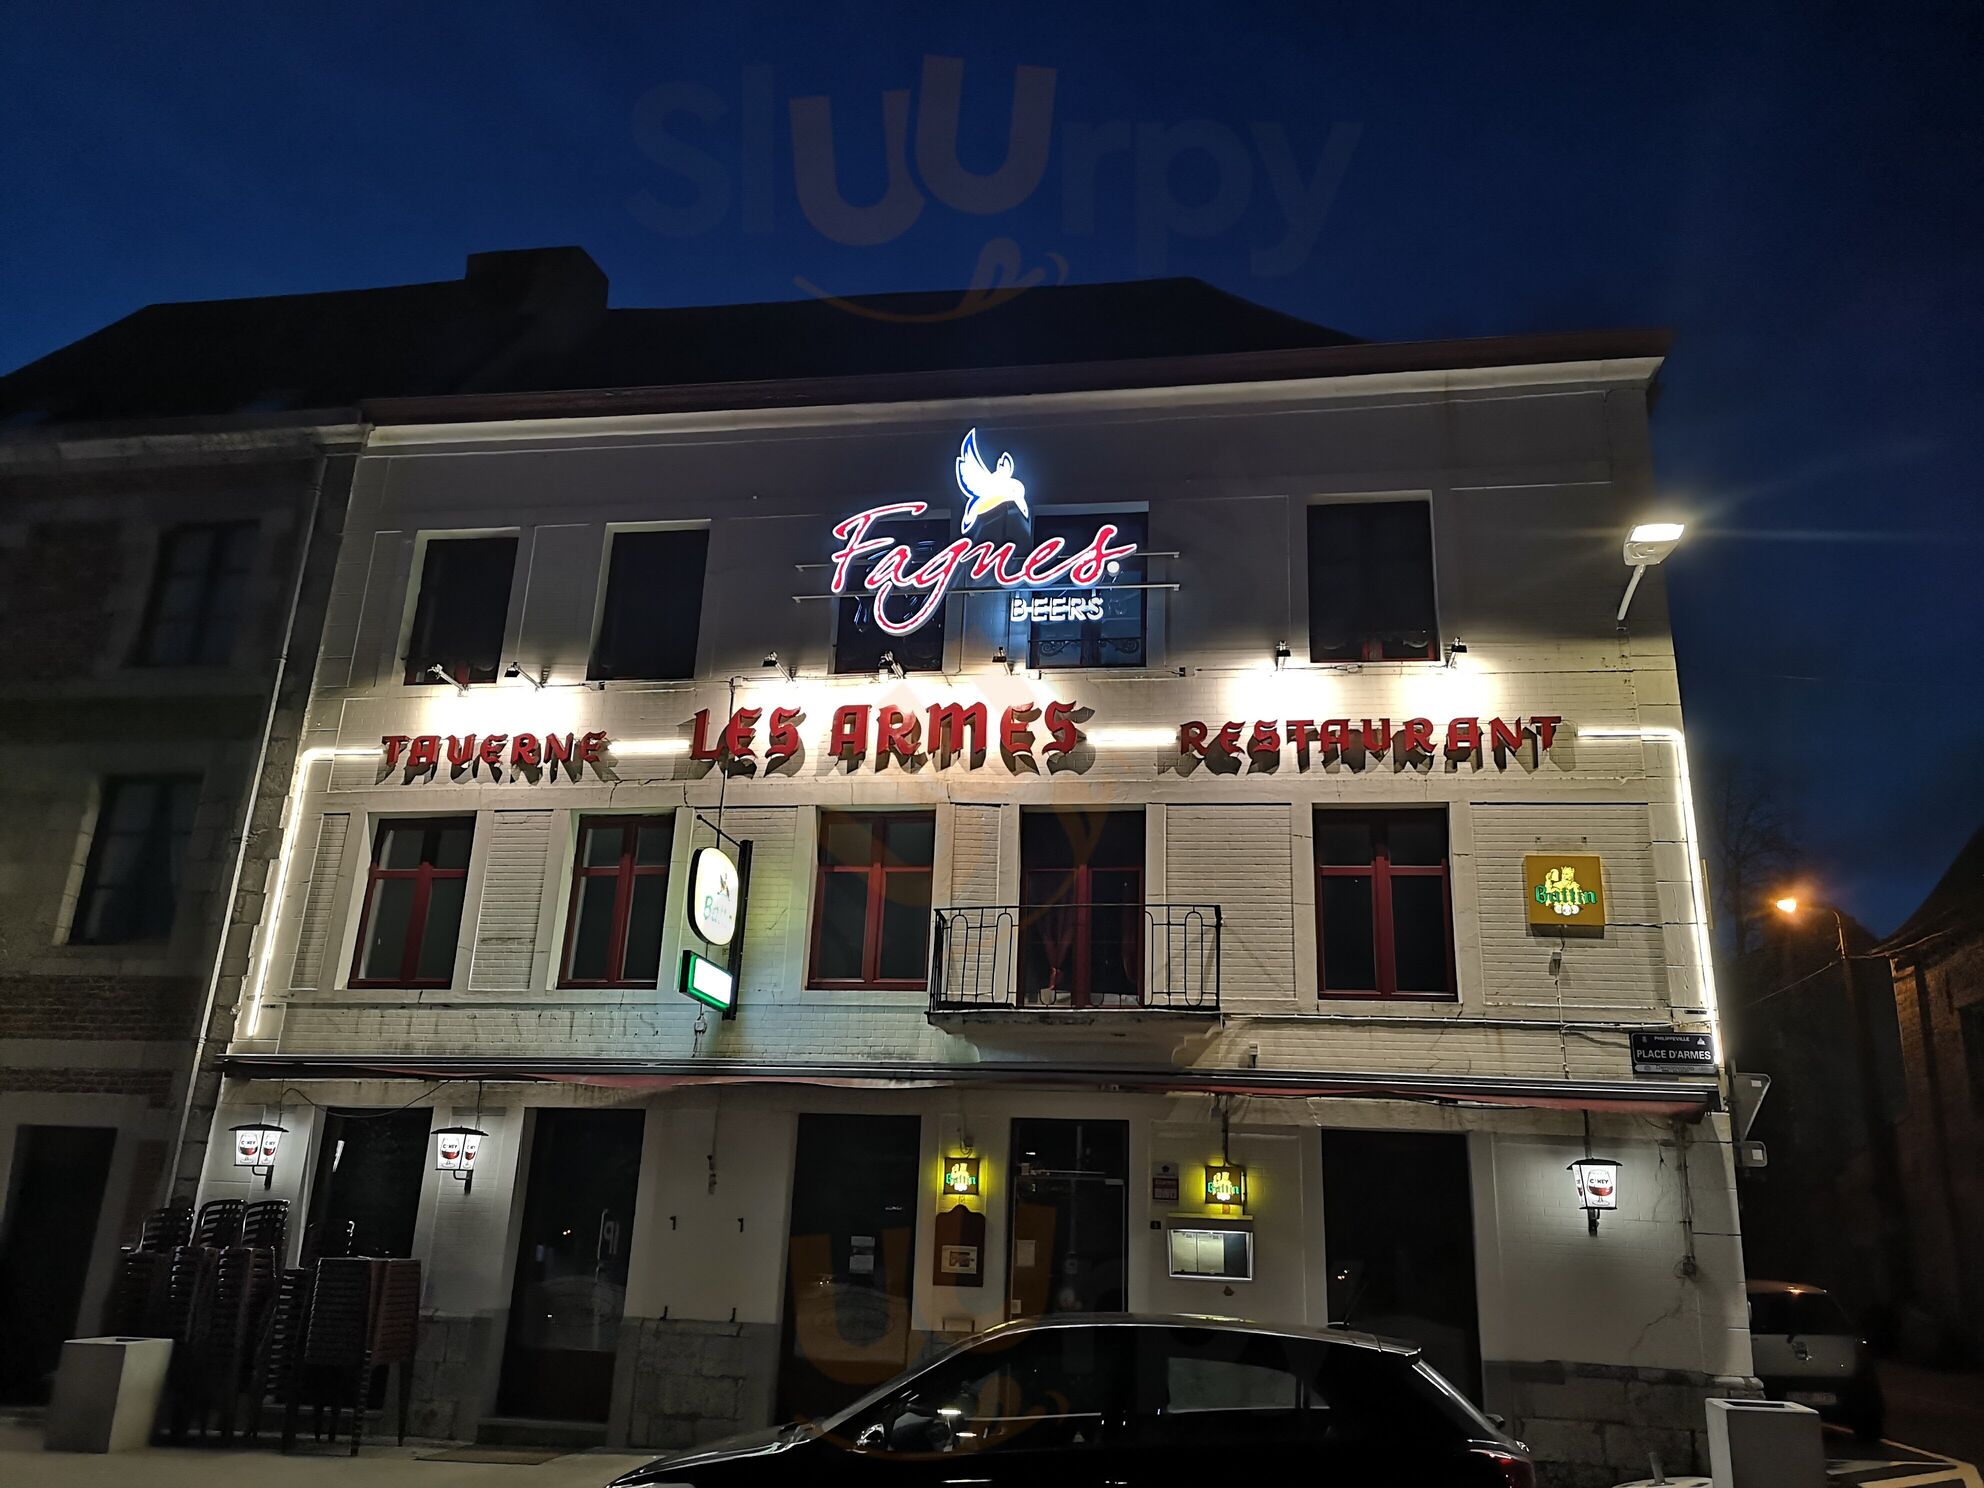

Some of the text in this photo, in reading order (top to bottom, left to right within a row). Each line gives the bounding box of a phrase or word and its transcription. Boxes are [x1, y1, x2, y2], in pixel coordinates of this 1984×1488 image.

[830, 501, 1138, 637] Fagnes
[1010, 595, 1105, 622] BEERS
[381, 700, 1562, 768] TAVERNE LES ARMES RESTAURANT
[1636, 1049, 1711, 1060] PLACE D'ARMES
